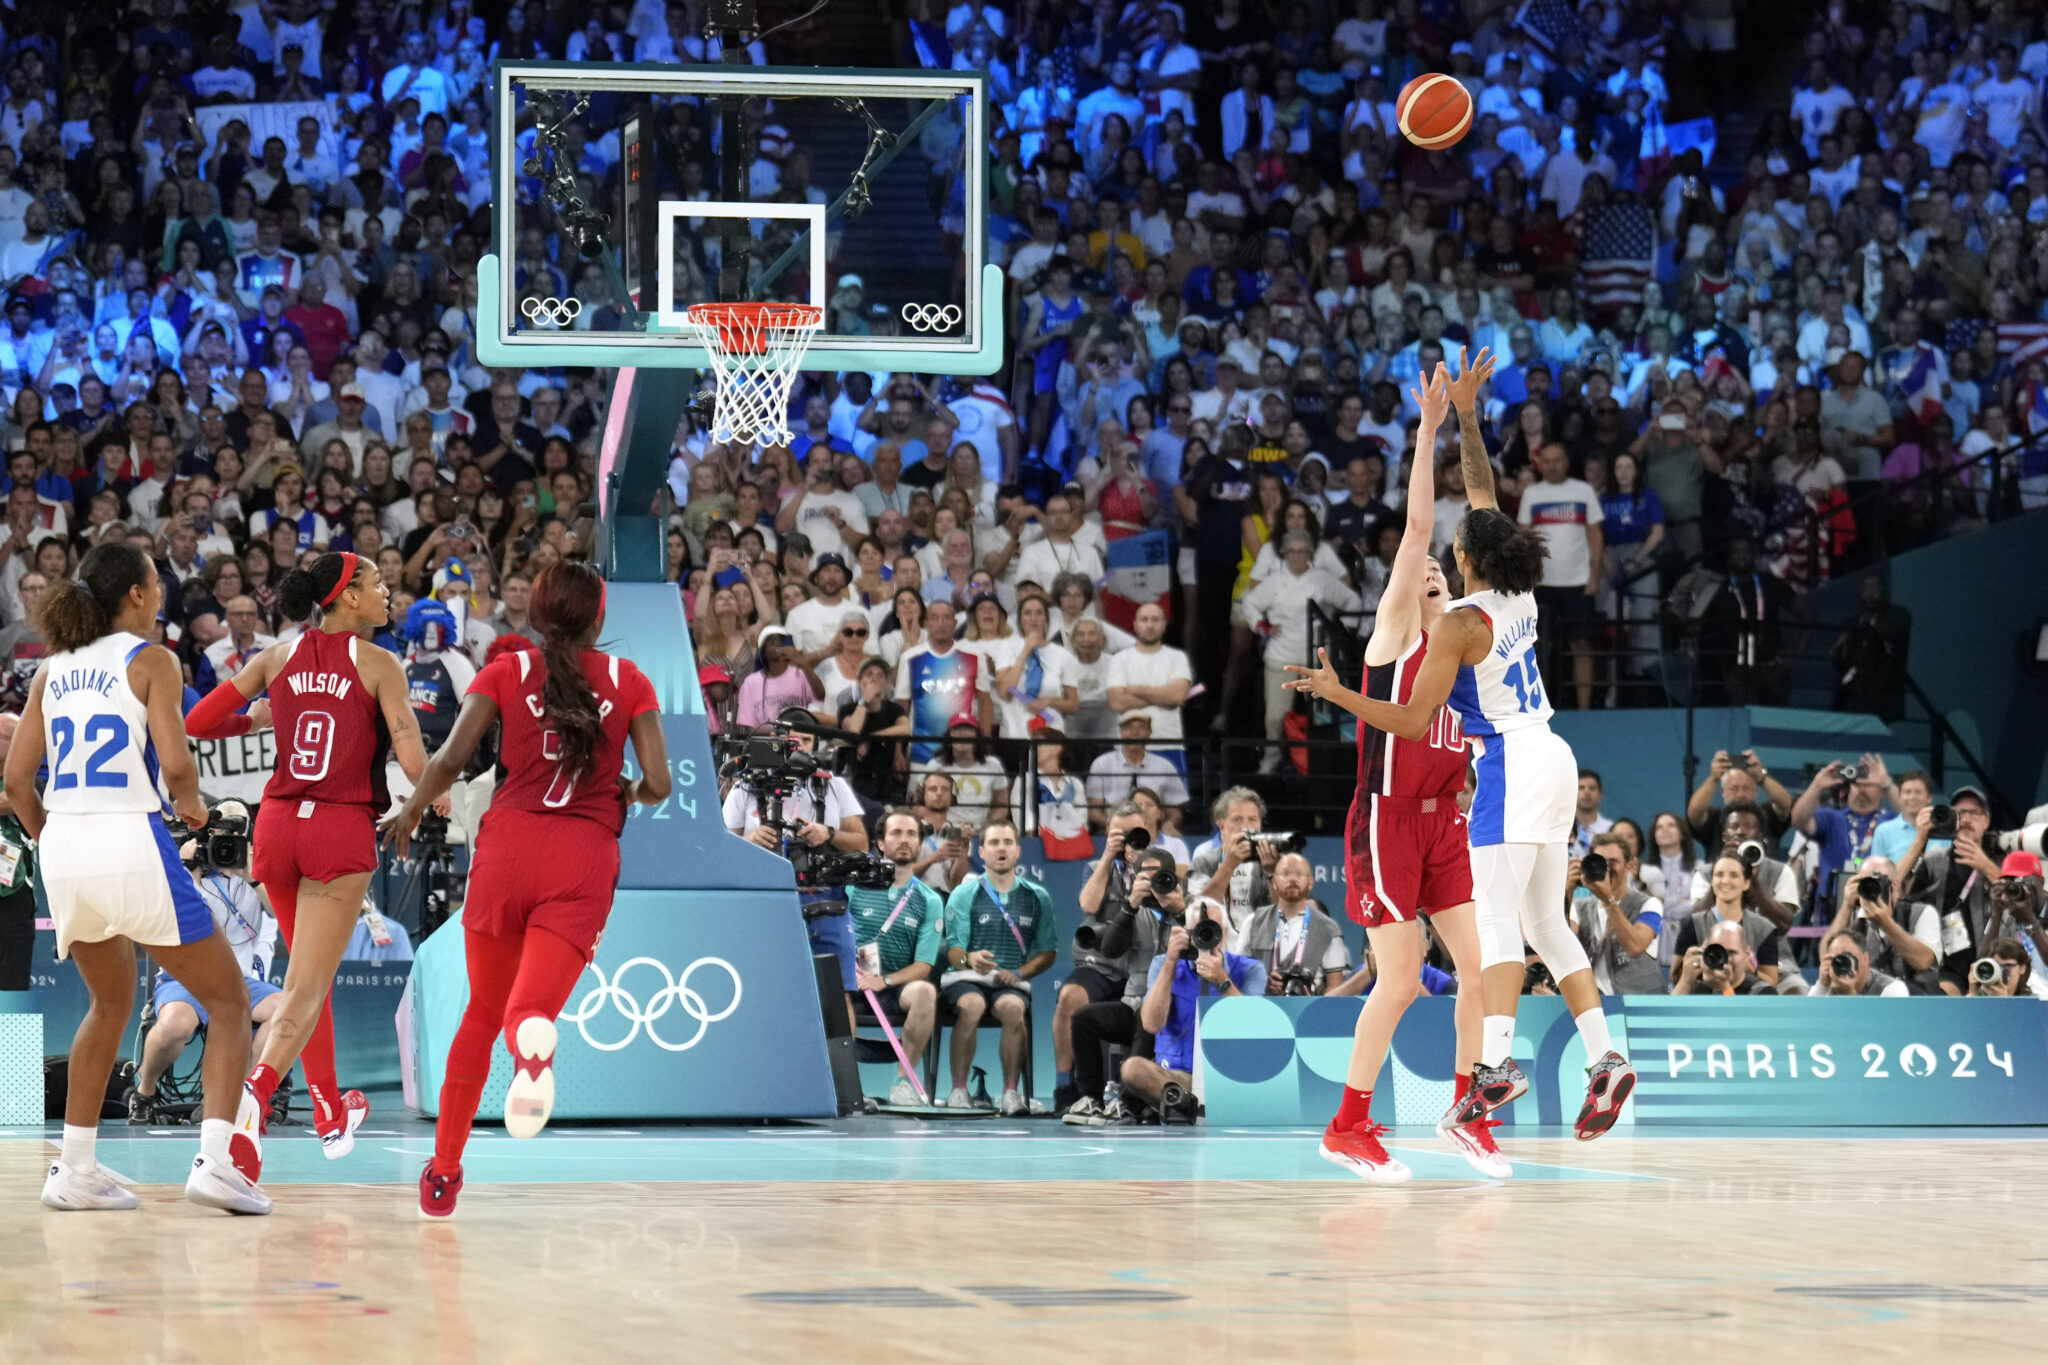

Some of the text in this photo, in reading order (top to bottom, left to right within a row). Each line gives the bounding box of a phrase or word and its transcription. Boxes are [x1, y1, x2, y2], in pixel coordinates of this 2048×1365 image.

[50, 669, 118, 700] BADIANE
[287, 672, 351, 700] WILSON
[410, 688, 438, 706] ANCE
[1502, 646, 1541, 713] 15
[51, 714, 129, 791] 22
[196, 729, 273, 777] RLEE
[290, 711, 335, 781] 9
[336, 976, 379, 986] PARIS
[1861, 1043, 2014, 1079] 2024
